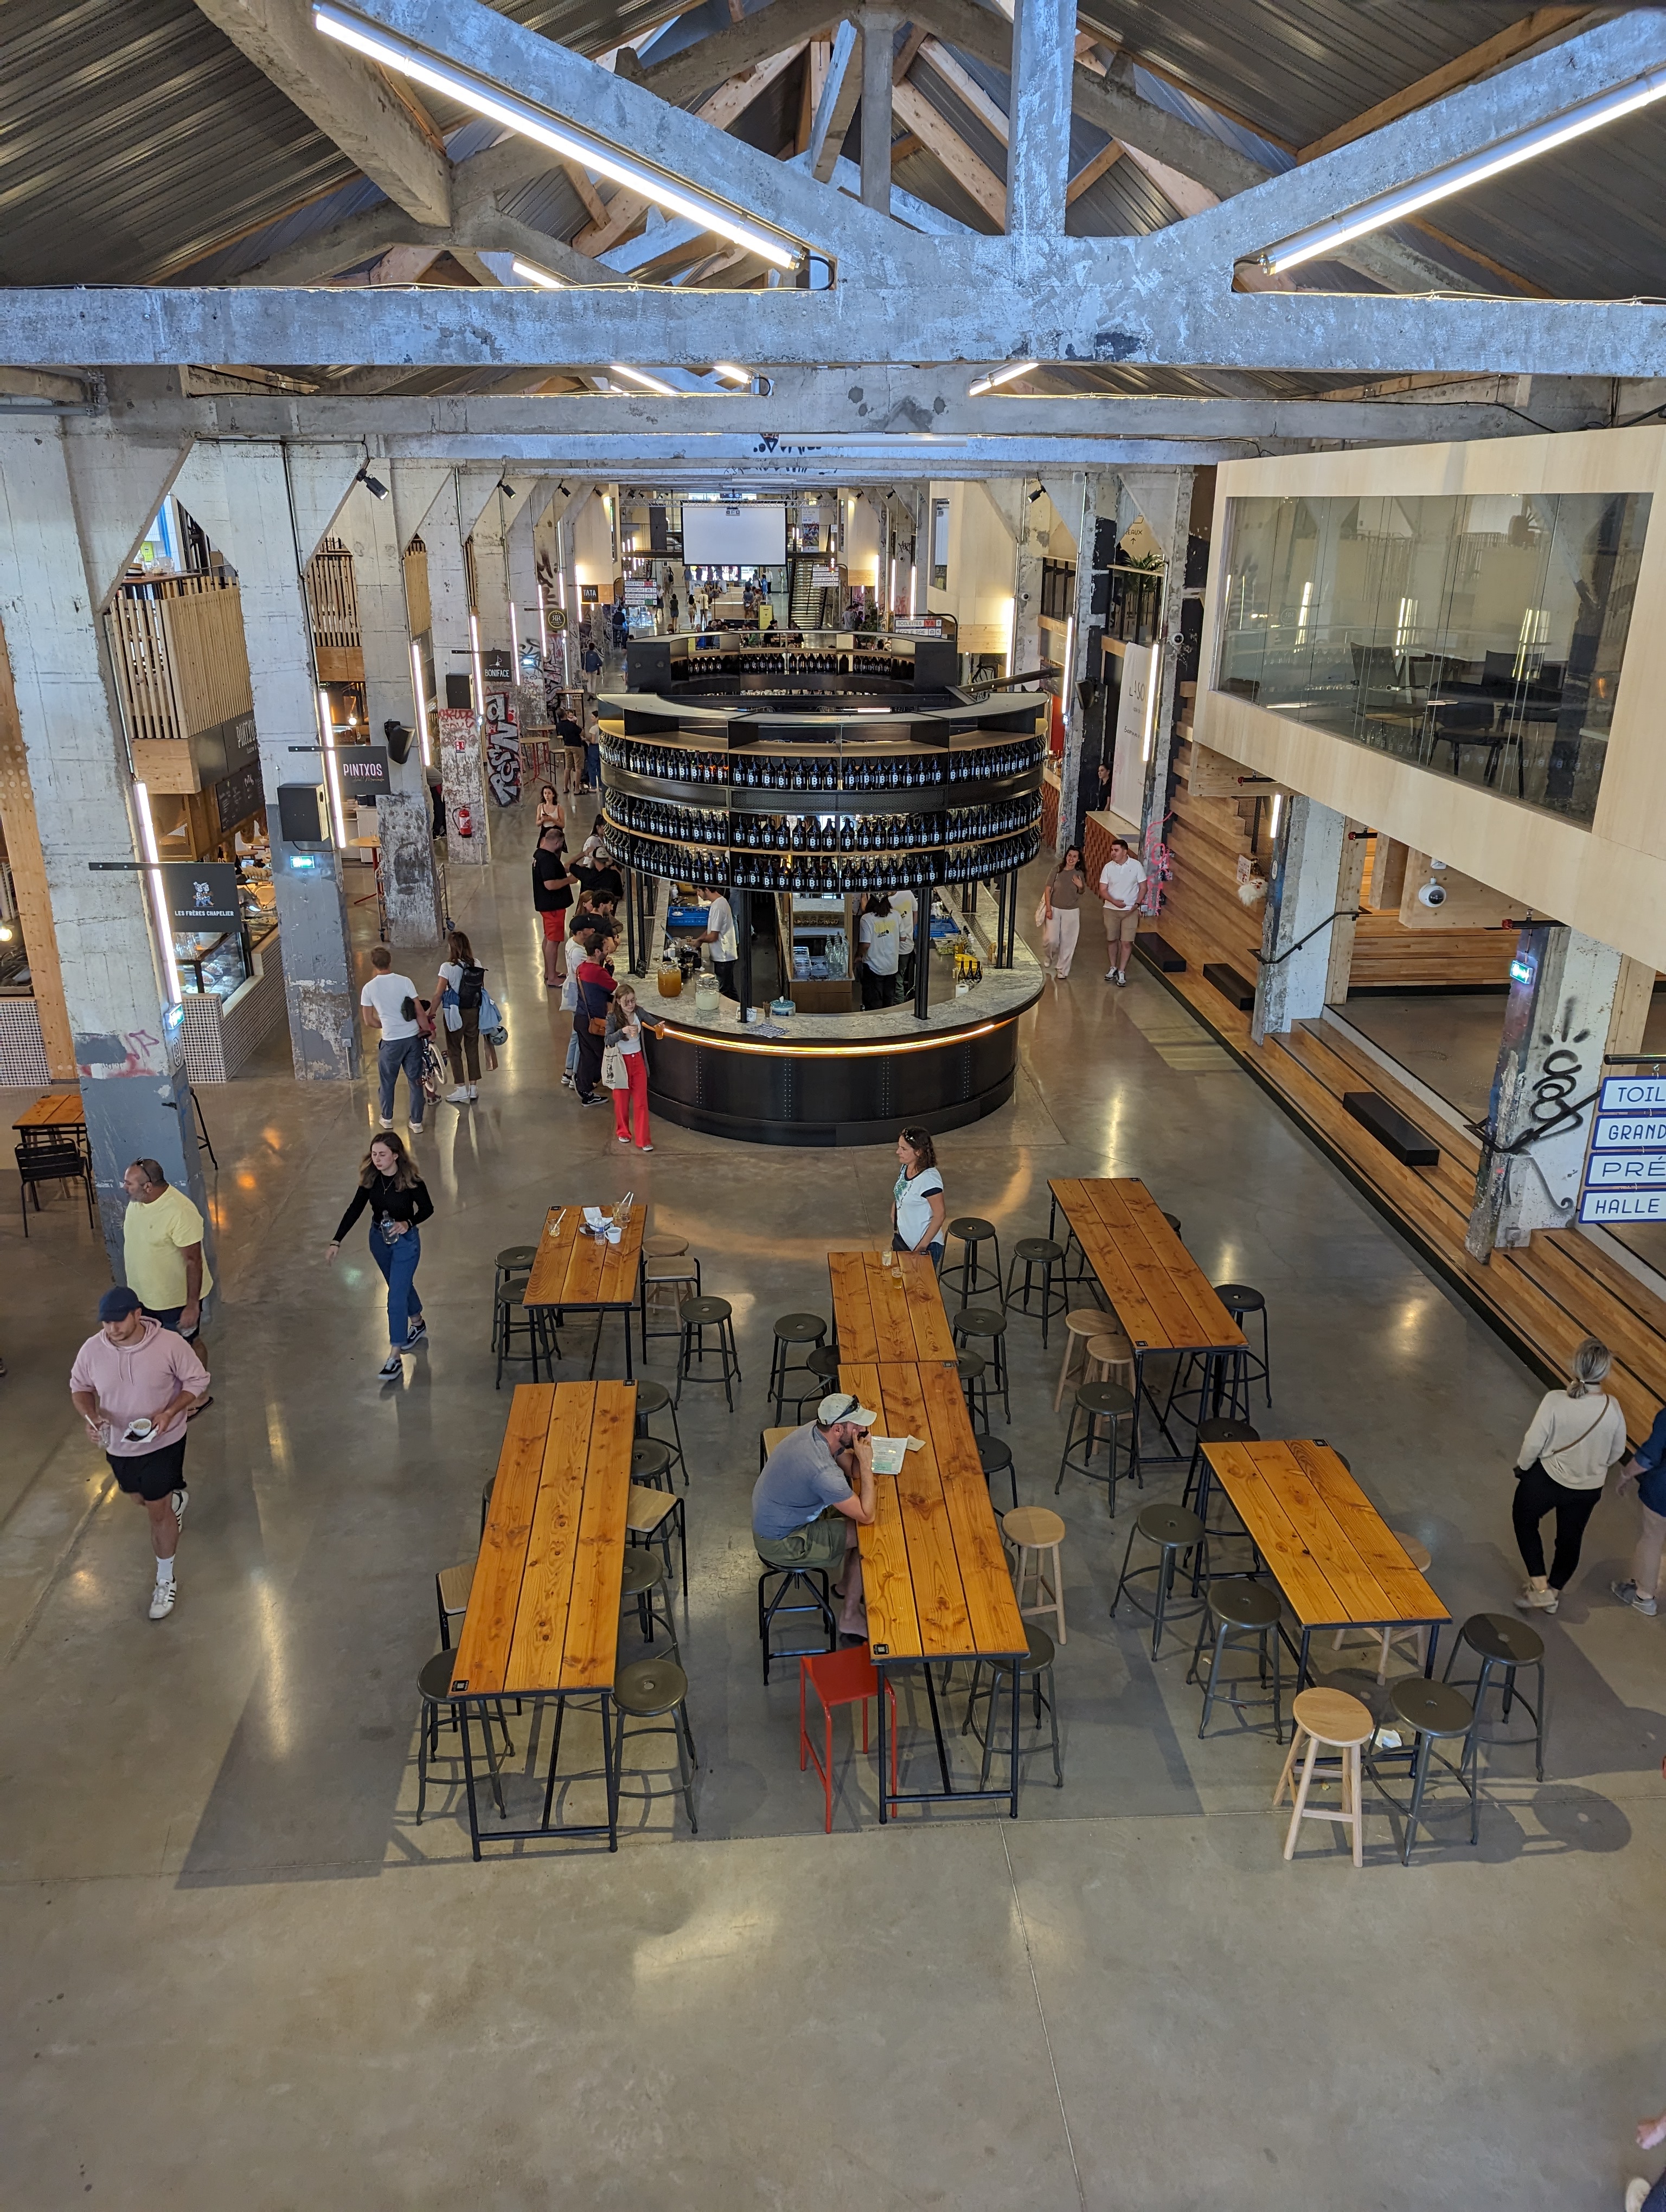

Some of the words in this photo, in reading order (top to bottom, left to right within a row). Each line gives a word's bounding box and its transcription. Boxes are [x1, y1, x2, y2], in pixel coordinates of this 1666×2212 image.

[484, 669, 510, 678] BONIFACE
[343, 763, 382, 776] PINTXOS
[656, 764, 661, 773] B
[691, 768, 697, 777] B
[975, 768, 980, 776] B
[985, 767, 989, 775] B
[704, 769, 710, 778] B
[717, 770, 723, 778] B
[735, 773, 741, 781] B
[950, 771, 956, 780] B
[963, 769, 968, 777] B
[748, 775, 754, 783] B
[764, 775, 770, 784] B
[778, 777, 784, 786] B
[796, 777, 802, 785] B
[811, 777, 818, 785] B
[826, 777, 833, 785] B
[849, 776, 855, 785] B
[864, 775, 869, 783] B
[880, 775, 885, 783] B
[893, 774, 898, 783] B
[906, 776, 912, 784] B
[919, 774, 925, 782] B
[650, 822, 655, 830] B
[659, 825, 663, 833] B
[669, 826, 674, 834] B
[973, 826, 977, 834] B
[982, 826, 987, 834] B
[680, 828, 685, 836] B
[694, 829, 700, 837] B
[706, 831, 712, 839] B
[717, 832, 721, 840] B
[735, 833, 741, 841] B
[749, 835, 755, 844] B
[764, 834, 771, 843] B
[779, 837, 785, 845] B
[793, 837, 799, 845] B
[863, 837, 869, 845] B
[894, 837, 899, 845] B
[922, 835, 927, 843] B
[934, 833, 940, 841] B
[810, 838, 816, 846] B
[845, 838, 851, 846] B
[680, 869, 685, 877] B
[691, 871, 696, 879] B
[704, 872, 709, 880] B
[717, 873, 723, 881] B
[736, 876, 742, 884] B
[751, 875, 756, 883] B
[764, 877, 770, 885] B
[877, 878, 882, 886] B
[917, 874, 922, 882] B
[795, 879, 801, 887] B
[1618, 1086, 1666, 1102] TOIL
[1609, 1124, 1666, 1140] GRAND
[1602, 1156, 1666, 1177] PRÉ
[1595, 1198, 1661, 1214] HALLE
